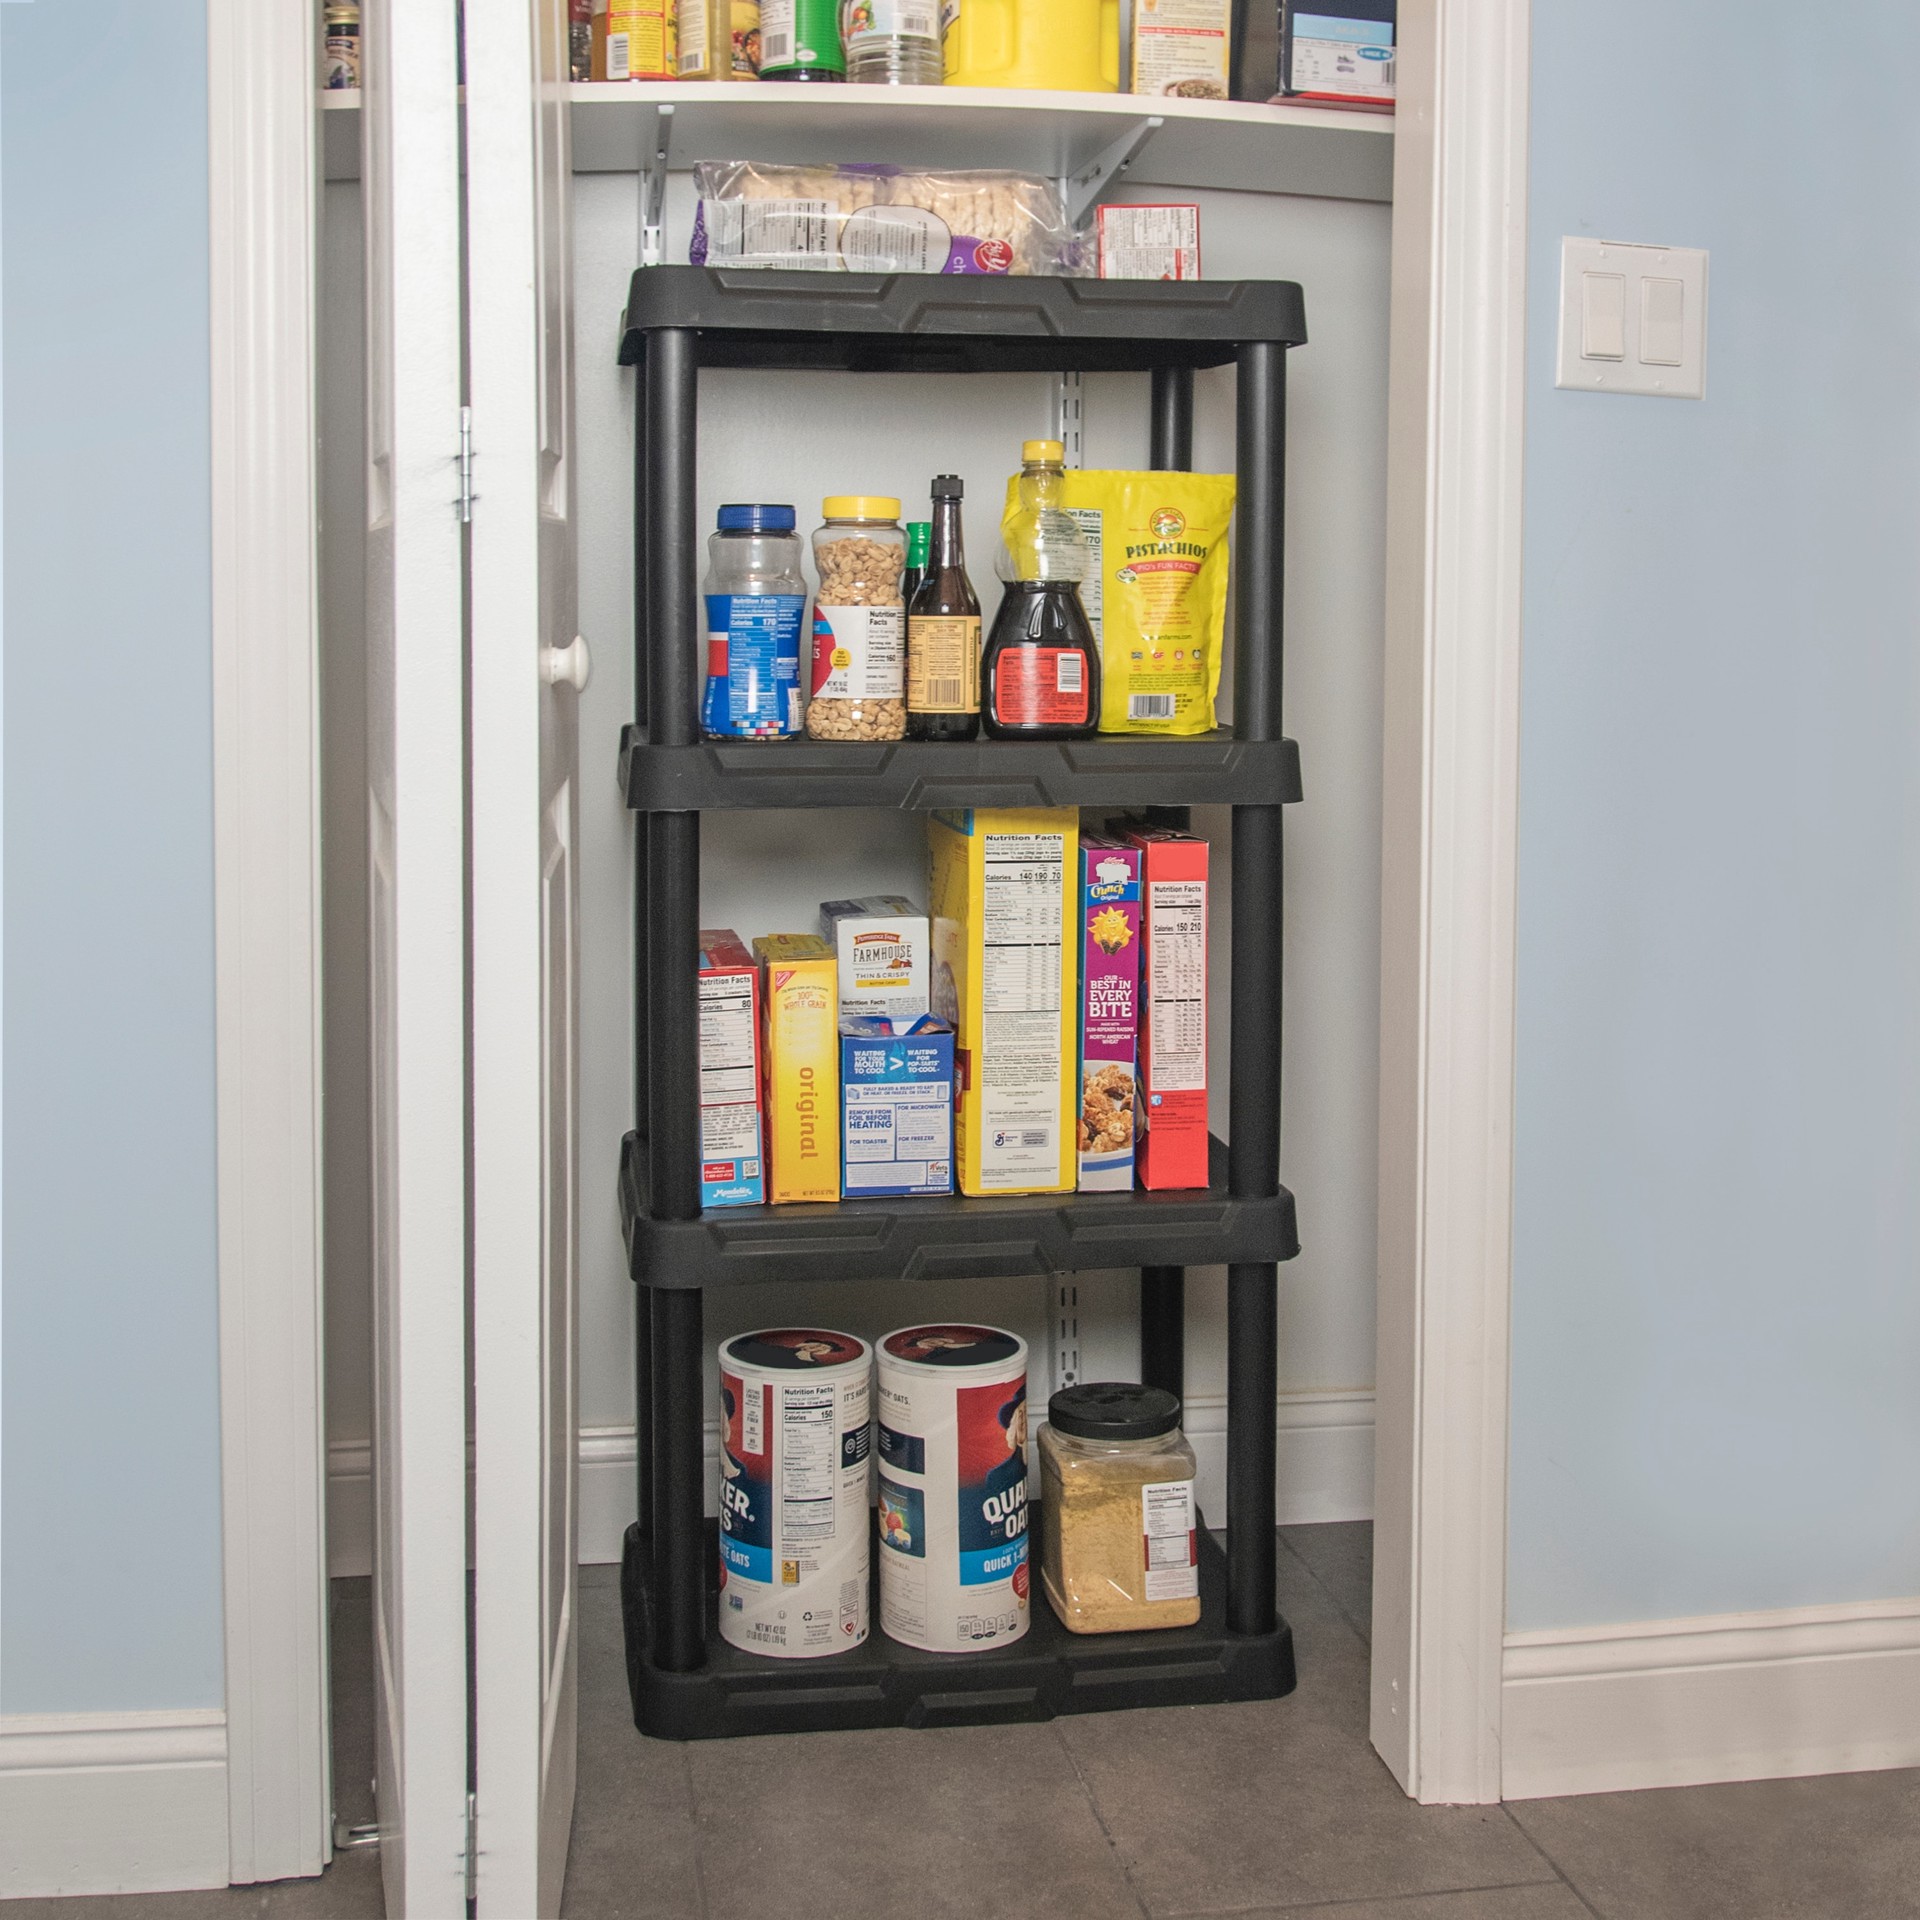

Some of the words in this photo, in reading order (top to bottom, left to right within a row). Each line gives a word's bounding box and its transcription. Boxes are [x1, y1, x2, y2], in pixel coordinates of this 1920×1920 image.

[1126, 542, 1208, 559] PISTACHIOS
[1157, 561, 1174, 570] FUN
[1174, 561, 1197, 572] FACTS
[732, 597, 759, 605] Nutrition
[761, 597, 778, 605] Facts
[1020, 872, 1033, 880] 140
[1035, 872, 1048, 880] 190
[1052, 872, 1062, 880] 70
[1091, 885, 1125, 898] Crunch
[1184, 885, 1202, 893] Facts
[1176, 923, 1188, 931] 150
[1190, 922, 1202, 931] 210
[853, 944, 912, 962] FARMHOUSE
[731, 976, 751, 984] Facts
[1090, 980, 1117, 990] BEST
[1118, 980, 1132, 990] IN
[798, 991, 813, 1000] 100%
[1089, 990, 1133, 1001] EVERY
[742, 999, 752, 1008] 80
[784, 1000, 805, 1010] WHOLE
[807, 1000, 827, 1009] GRAIN
[1088, 1001, 1133, 1018] BITE
[854, 1060, 886, 1069] MOUTH
[796, 1067, 819, 1160] original
[849, 1120, 893, 1129] HEATING
[816, 1386, 834, 1394] Facts
[843, 1391, 855, 1402] IT'S
[893, 1393, 911, 1406] OATS.
[821, 1410, 833, 1419] 150
[731, 1549, 751, 1568] OATS
[983, 1553, 1012, 1573] QUICK
[755, 1622, 764, 1632] NET
[764, 1624, 772, 1633] WT
[773, 1625, 779, 1634] 42
[780, 1626, 787, 1635] OZ
